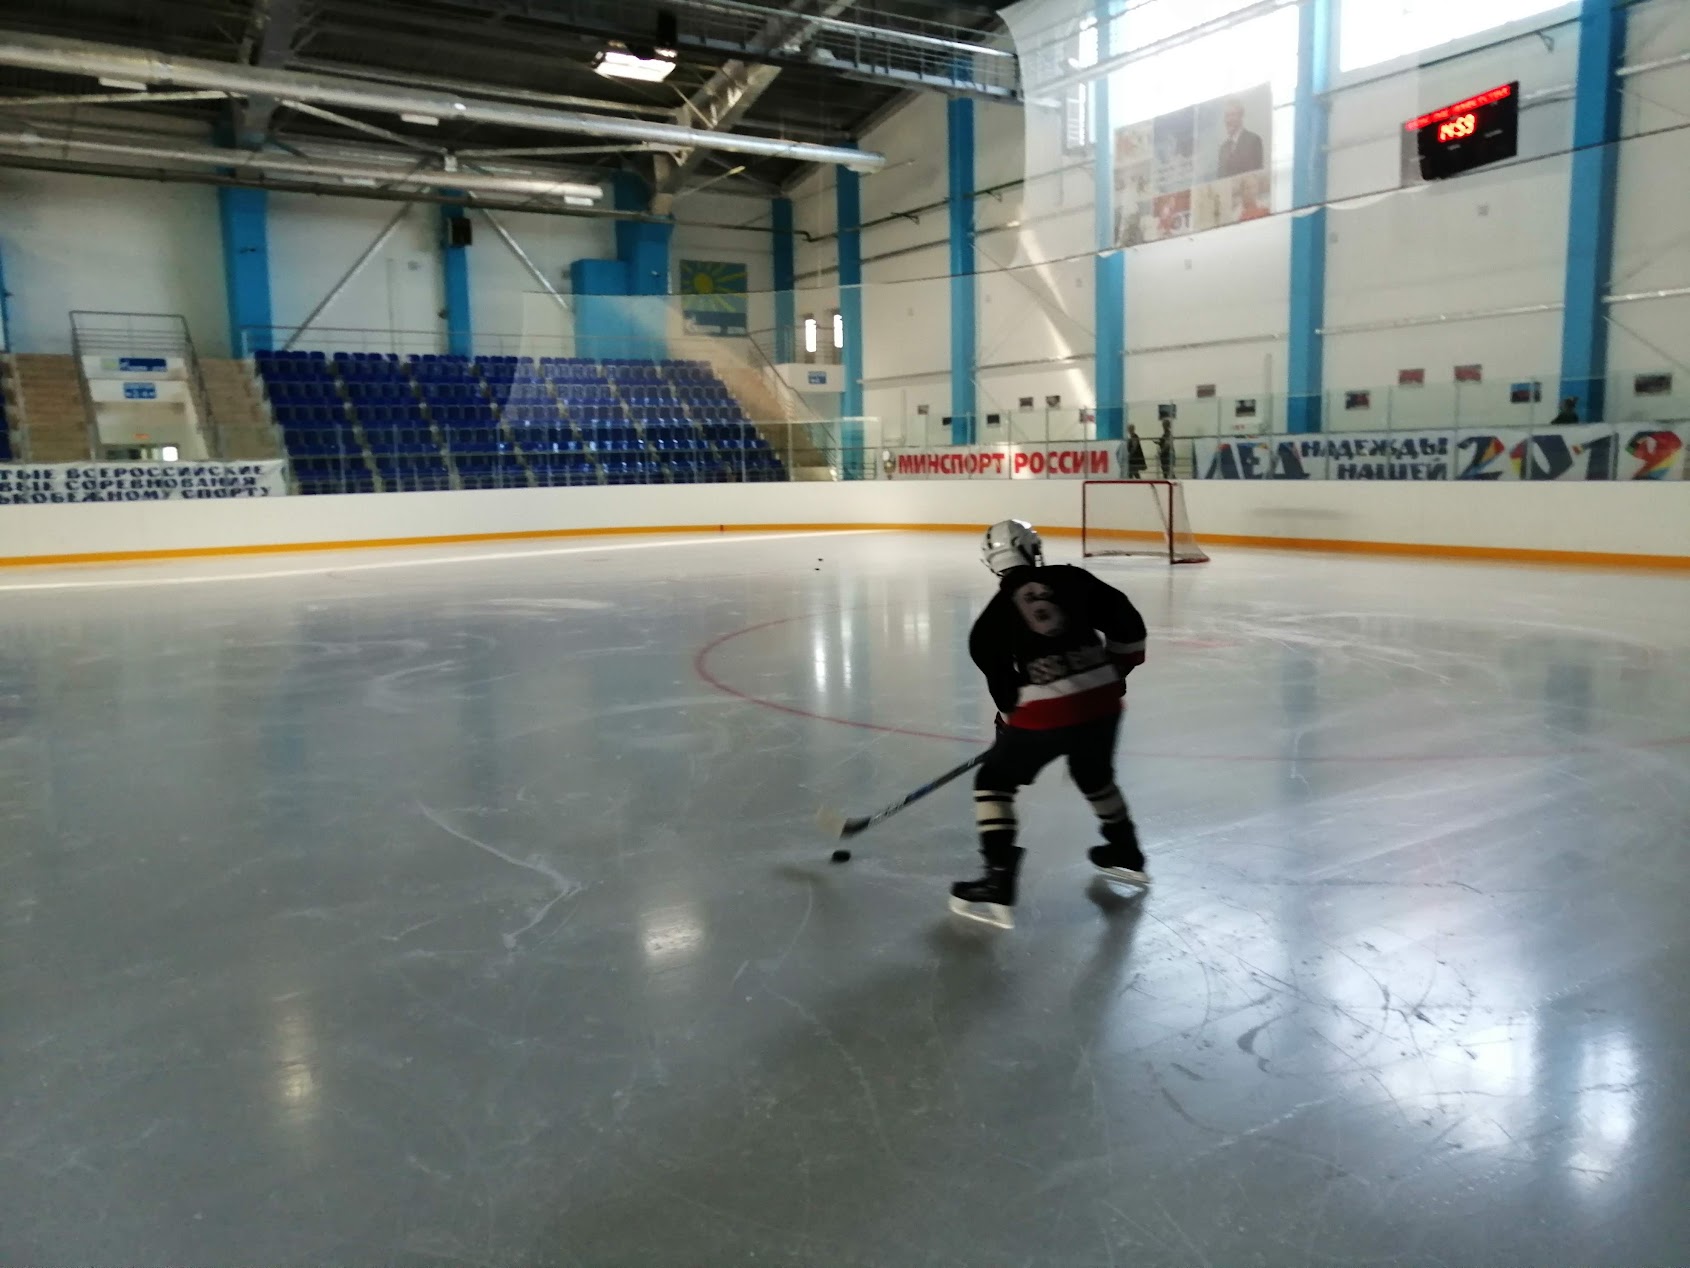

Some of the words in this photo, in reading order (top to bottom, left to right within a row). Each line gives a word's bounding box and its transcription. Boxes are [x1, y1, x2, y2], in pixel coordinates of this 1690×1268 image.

[898, 453, 1005, 475] МИНСПОРТ
[1014, 450, 1109, 475] РОССИИ
[1206, 442, 1310, 480] ЛЕД
[1337, 457, 1448, 481] НАШЕЙ
[1456, 431, 1683, 481] 2019
